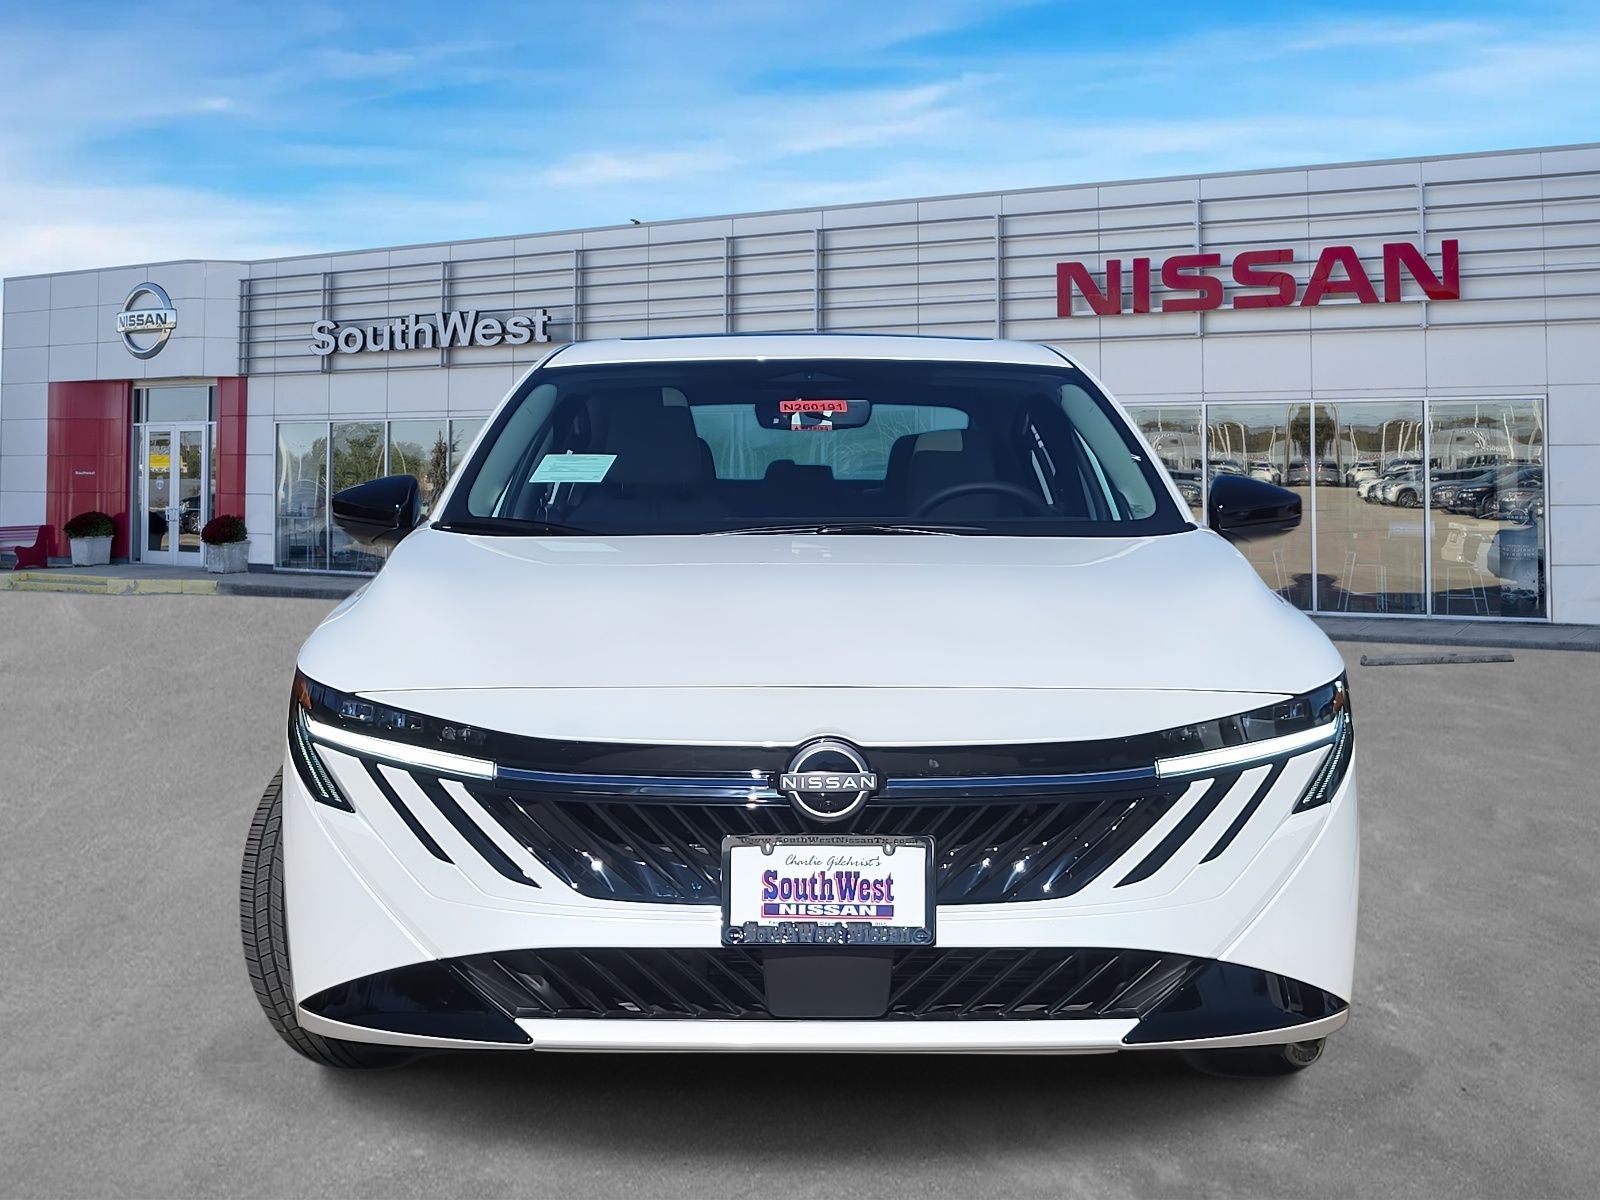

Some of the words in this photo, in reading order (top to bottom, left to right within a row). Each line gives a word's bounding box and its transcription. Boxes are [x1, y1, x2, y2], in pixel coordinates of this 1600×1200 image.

[1056, 238, 1461, 319] NISSAN
[118, 312, 168, 328] NISSAN
[309, 308, 551, 356] SouthWest
[783, 403, 843, 411] N260191
[782, 776, 875, 789] NISSAN
[785, 854, 822, 866] Charlie
[761, 869, 895, 903] SouthWest
[778, 903, 877, 916] NISSAN
